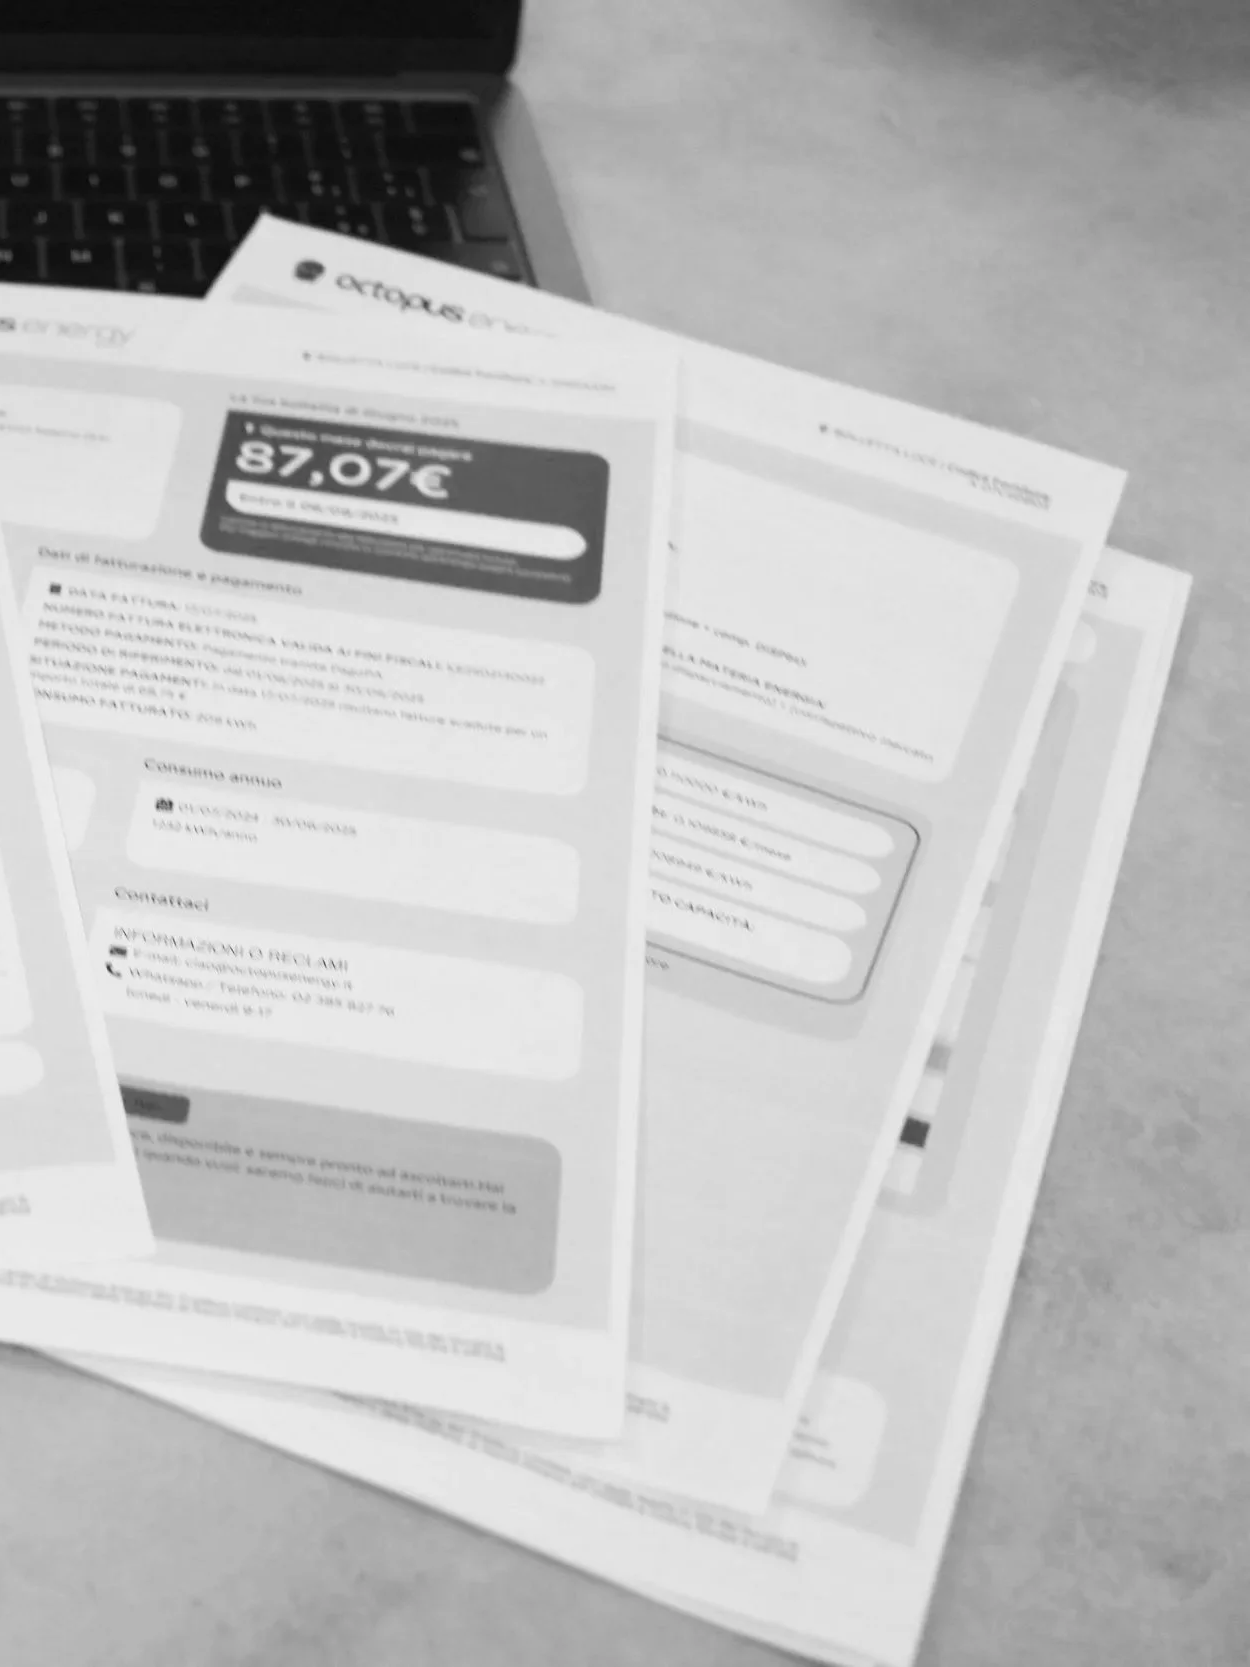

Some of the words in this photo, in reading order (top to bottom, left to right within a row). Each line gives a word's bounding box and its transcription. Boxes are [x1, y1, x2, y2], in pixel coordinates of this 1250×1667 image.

[335, 273, 465, 323] octopus
[235, 440, 452, 499] 87,07€
[144, 758, 225, 781] Consumo
[229, 771, 283, 789] annuo
[114, 886, 210, 912] Contattaci
[114, 926, 245, 959] INFORMAZIONI
